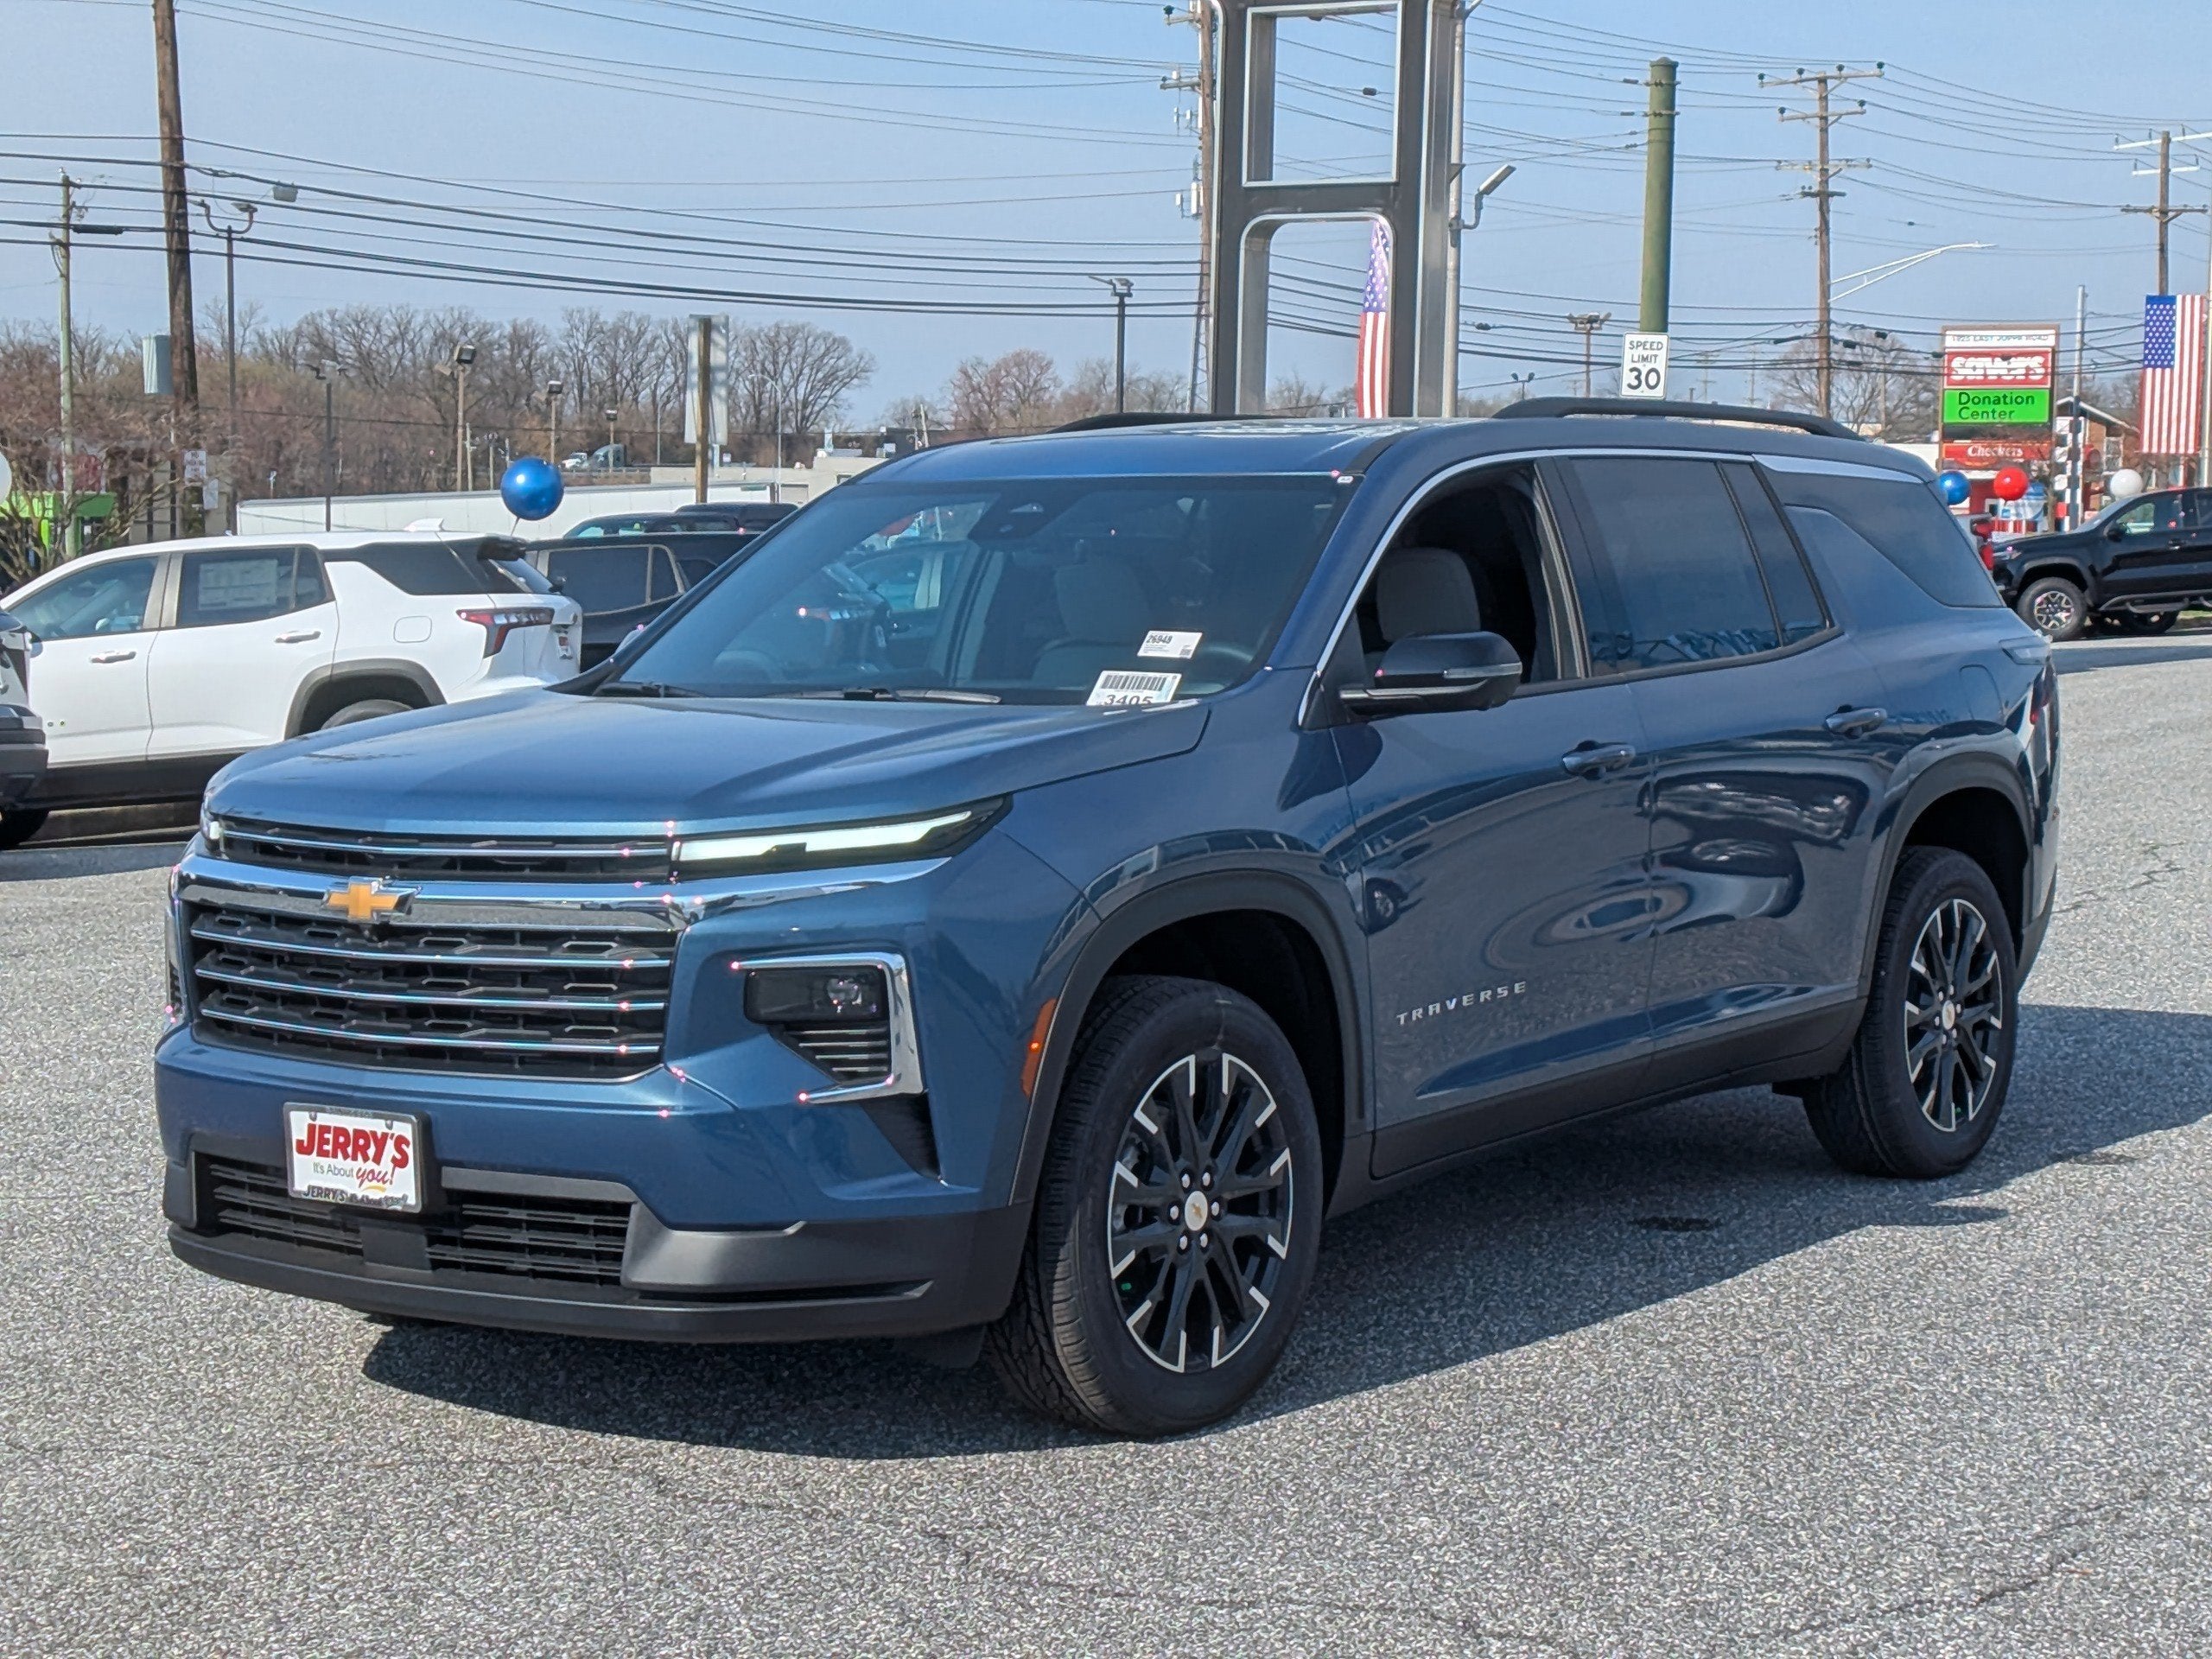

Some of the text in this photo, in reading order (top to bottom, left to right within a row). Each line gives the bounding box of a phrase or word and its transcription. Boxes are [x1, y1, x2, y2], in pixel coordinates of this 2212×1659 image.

[1628, 340, 1663, 351] SPEED
[1630, 353, 1658, 364] LIMIT
[1627, 367, 1661, 391] 30
[1958, 391, 2035, 405] Donation
[1958, 406, 2015, 420] Center
[1967, 444, 2024, 457] Checkers
[1106, 694, 1154, 705] 3405
[1396, 981, 1527, 1027] TRAVERSE
[296, 1122, 411, 1170] JERRY'S
[312, 1160, 397, 1189] It's About you!
[302, 1184, 347, 1203] JERRY'S
